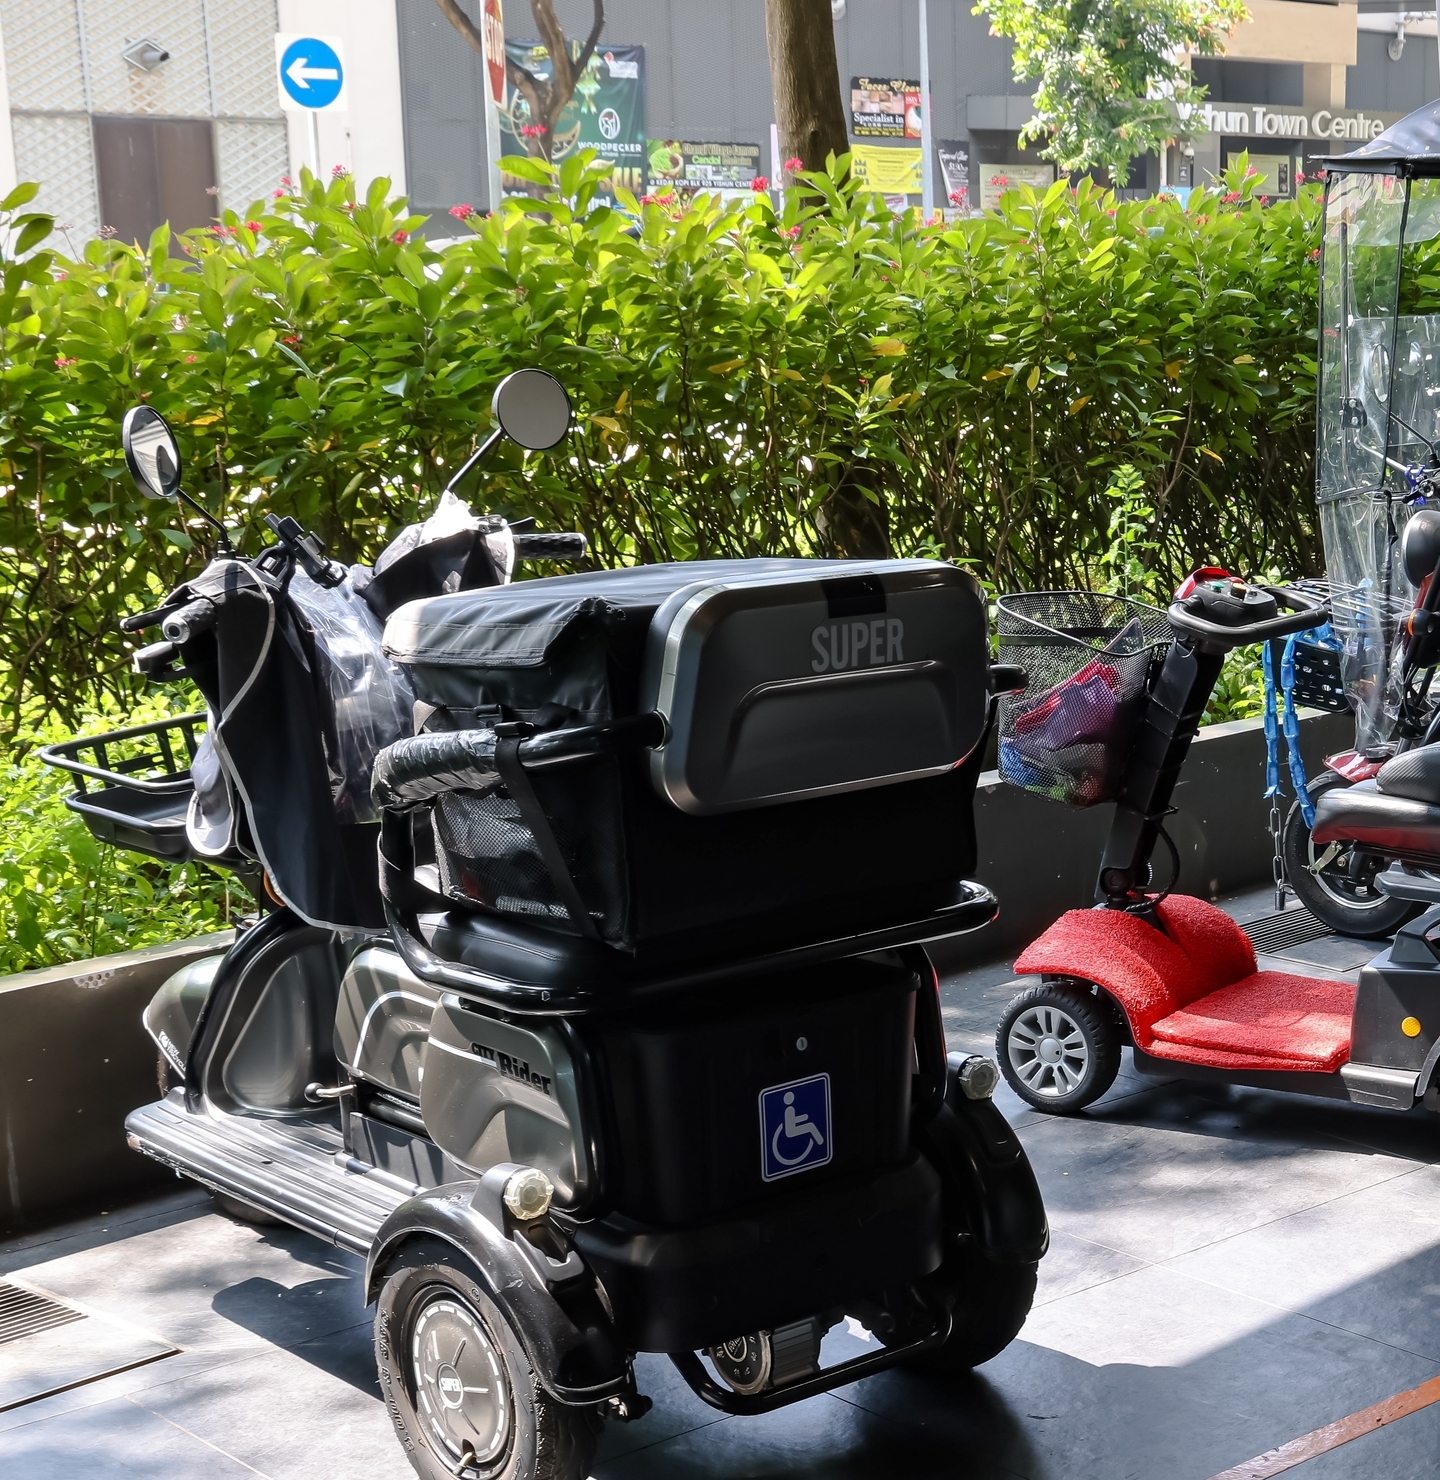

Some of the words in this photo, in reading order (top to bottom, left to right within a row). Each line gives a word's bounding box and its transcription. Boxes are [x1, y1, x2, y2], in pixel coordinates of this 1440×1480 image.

[485, 12, 503, 68] STOP
[854, 112, 894, 125] Specialist
[895, 115, 904, 124] in
[1252, 106, 1307, 136] Town
[1311, 110, 1384, 139] Centre
[577, 141, 642, 153] WOODPECKER
[811, 618, 904, 673] SUPER
[471, 1042, 496, 1061] CITY
[498, 1051, 553, 1096] Rider
[440, 1377, 461, 1392] SUPER
